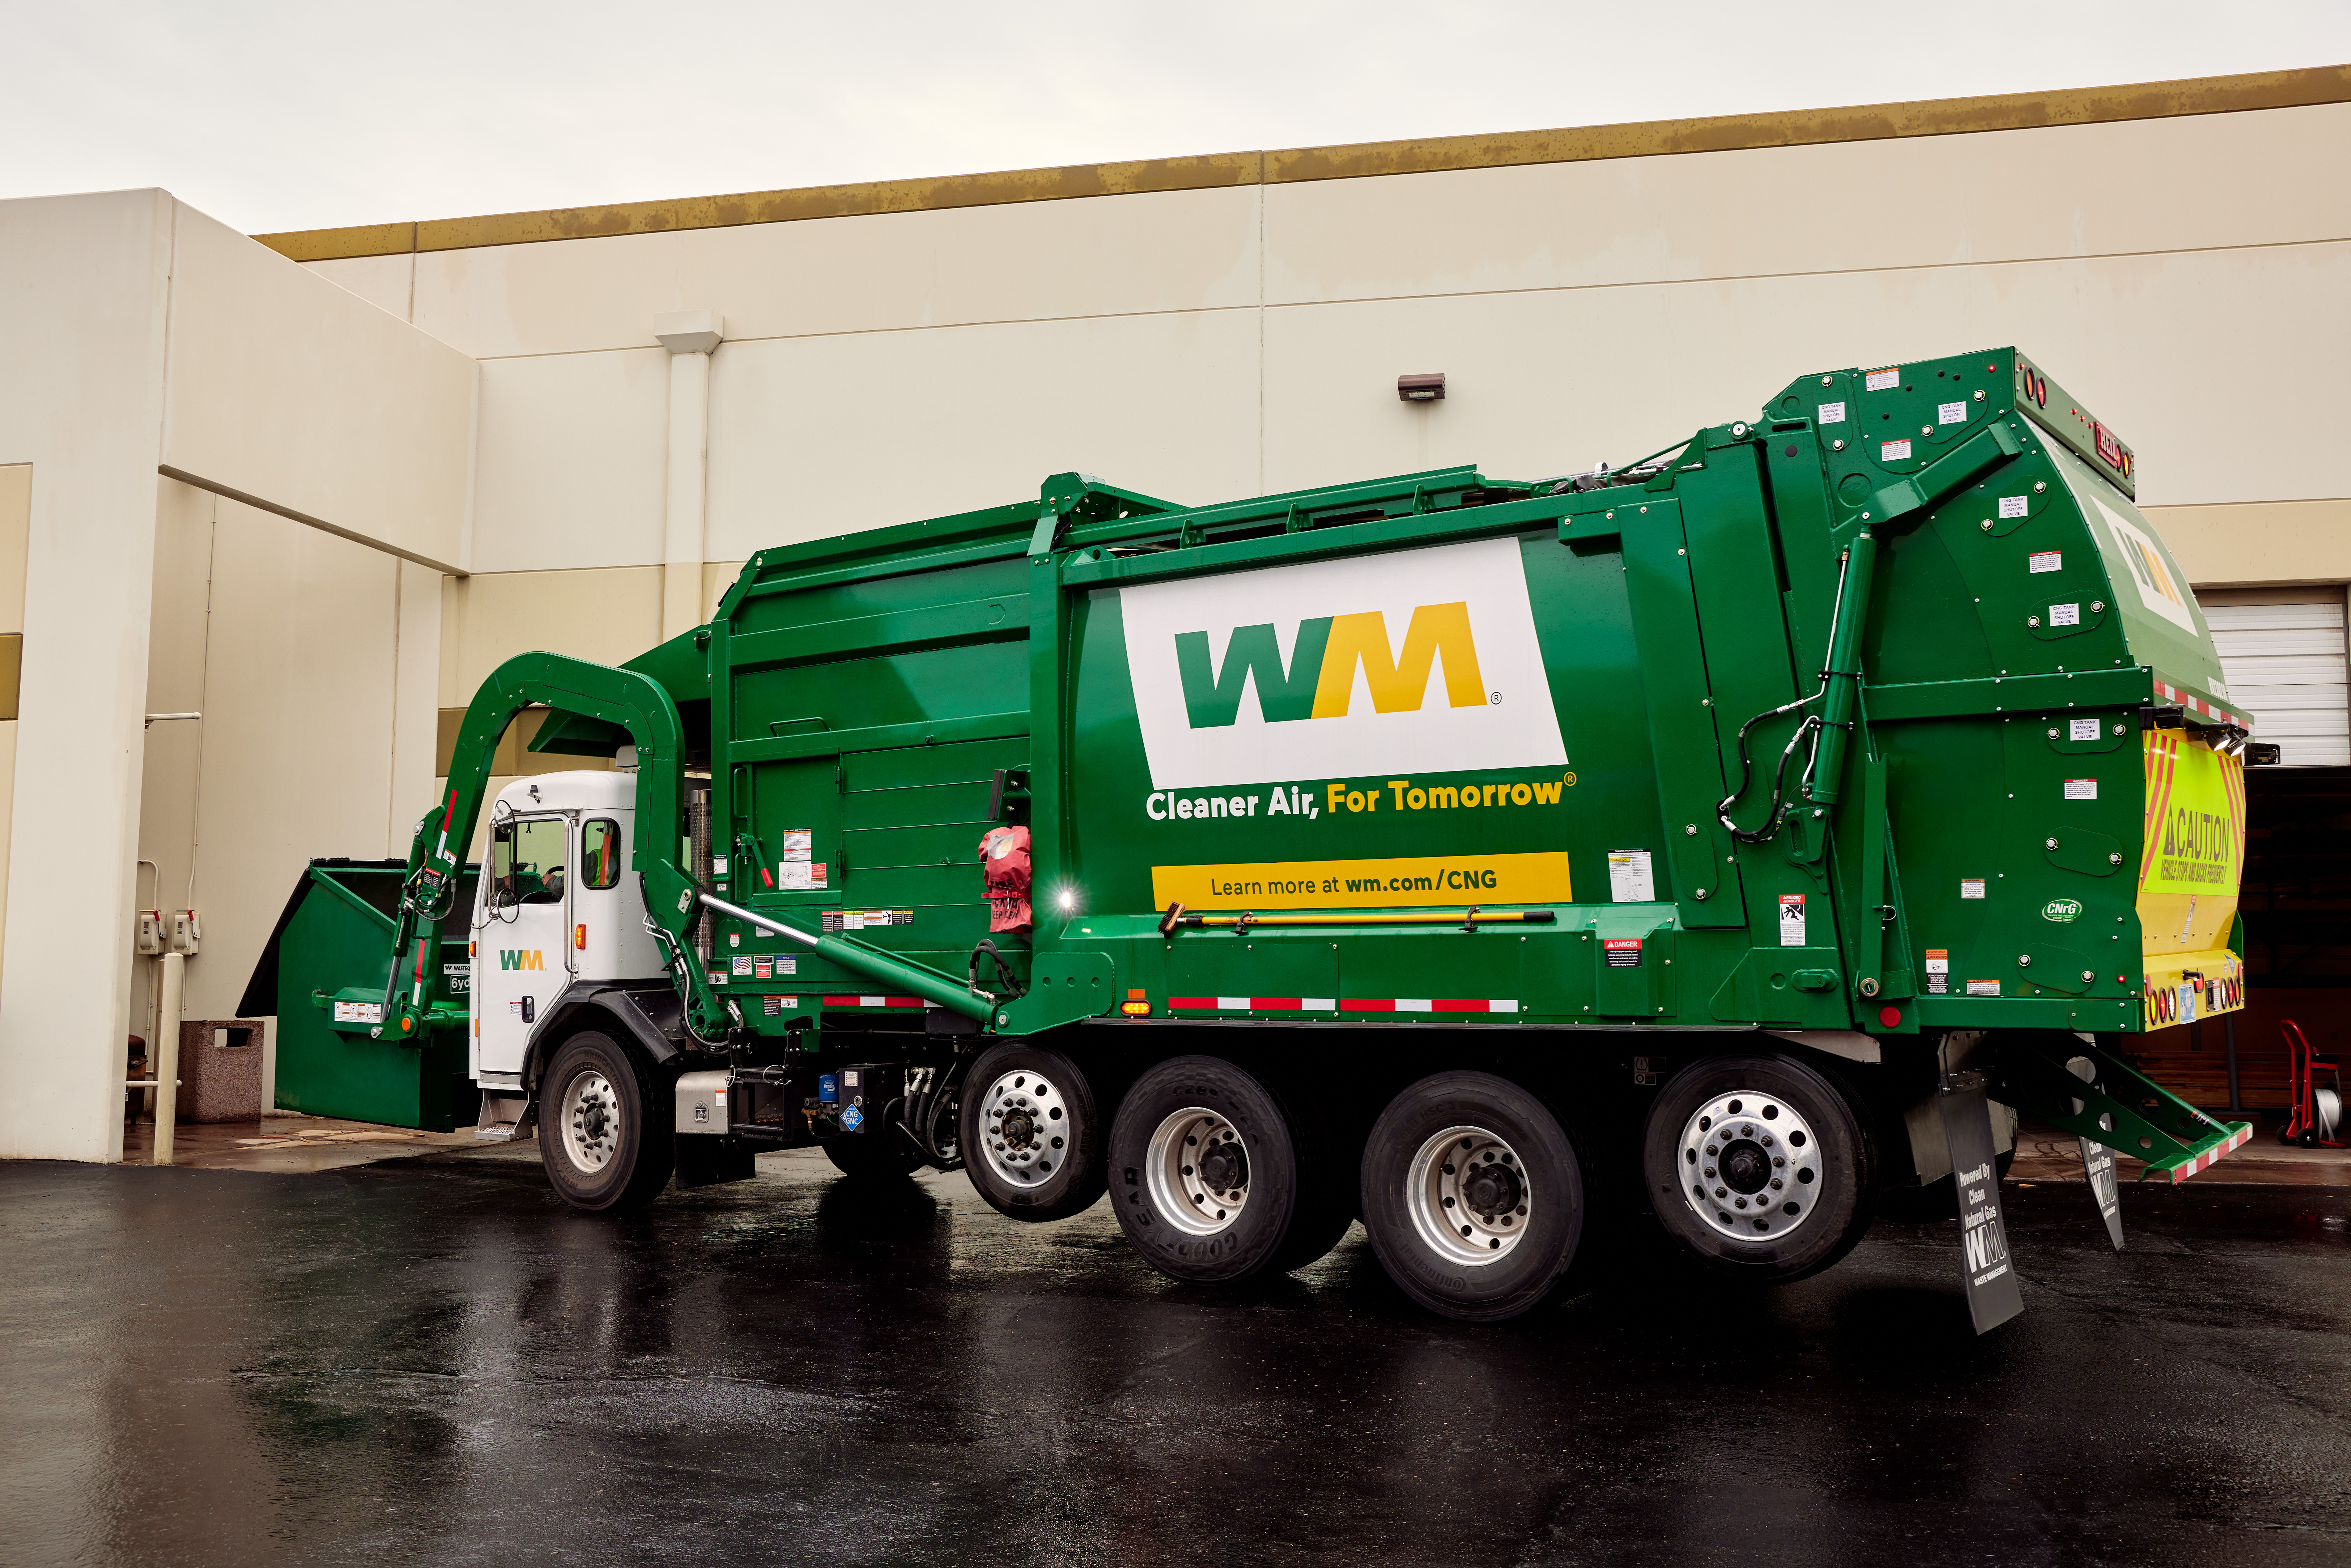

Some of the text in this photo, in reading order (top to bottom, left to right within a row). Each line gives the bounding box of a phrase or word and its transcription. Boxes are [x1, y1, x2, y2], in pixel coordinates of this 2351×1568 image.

[2100, 428, 2117, 459] HEIL
[2115, 526, 2184, 608] WM
[1174, 602, 1487, 728] WM
[1147, 793, 1259, 821] Cleaner
[1267, 786, 1319, 819] Air,
[1327, 784, 1378, 812] For
[2177, 808, 2229, 862] CAUTION
[1211, 869, 1497, 896] Learn more at wm.com/CNG
[2161, 859, 2227, 885] VEHICLE STOPS AND BACKS FREQUENTLY
[2047, 903, 2076, 914] CNrG
[500, 950, 544, 970] WM
[452, 977, 470, 990] 6yd
[2089, 1142, 2102, 1155] Clean
[1959, 1163, 1990, 1187] Powered By
[2087, 1156, 2110, 1175] Natural Gas
[1969, 1189, 1985, 1205] Clean
[2091, 1169, 2114, 1210] WM
[1965, 1205, 1997, 1230] Natural Gas
[1965, 1221, 2004, 1273] WM
[1974, 1264, 2007, 1287] WASTE MANAGEMENT
